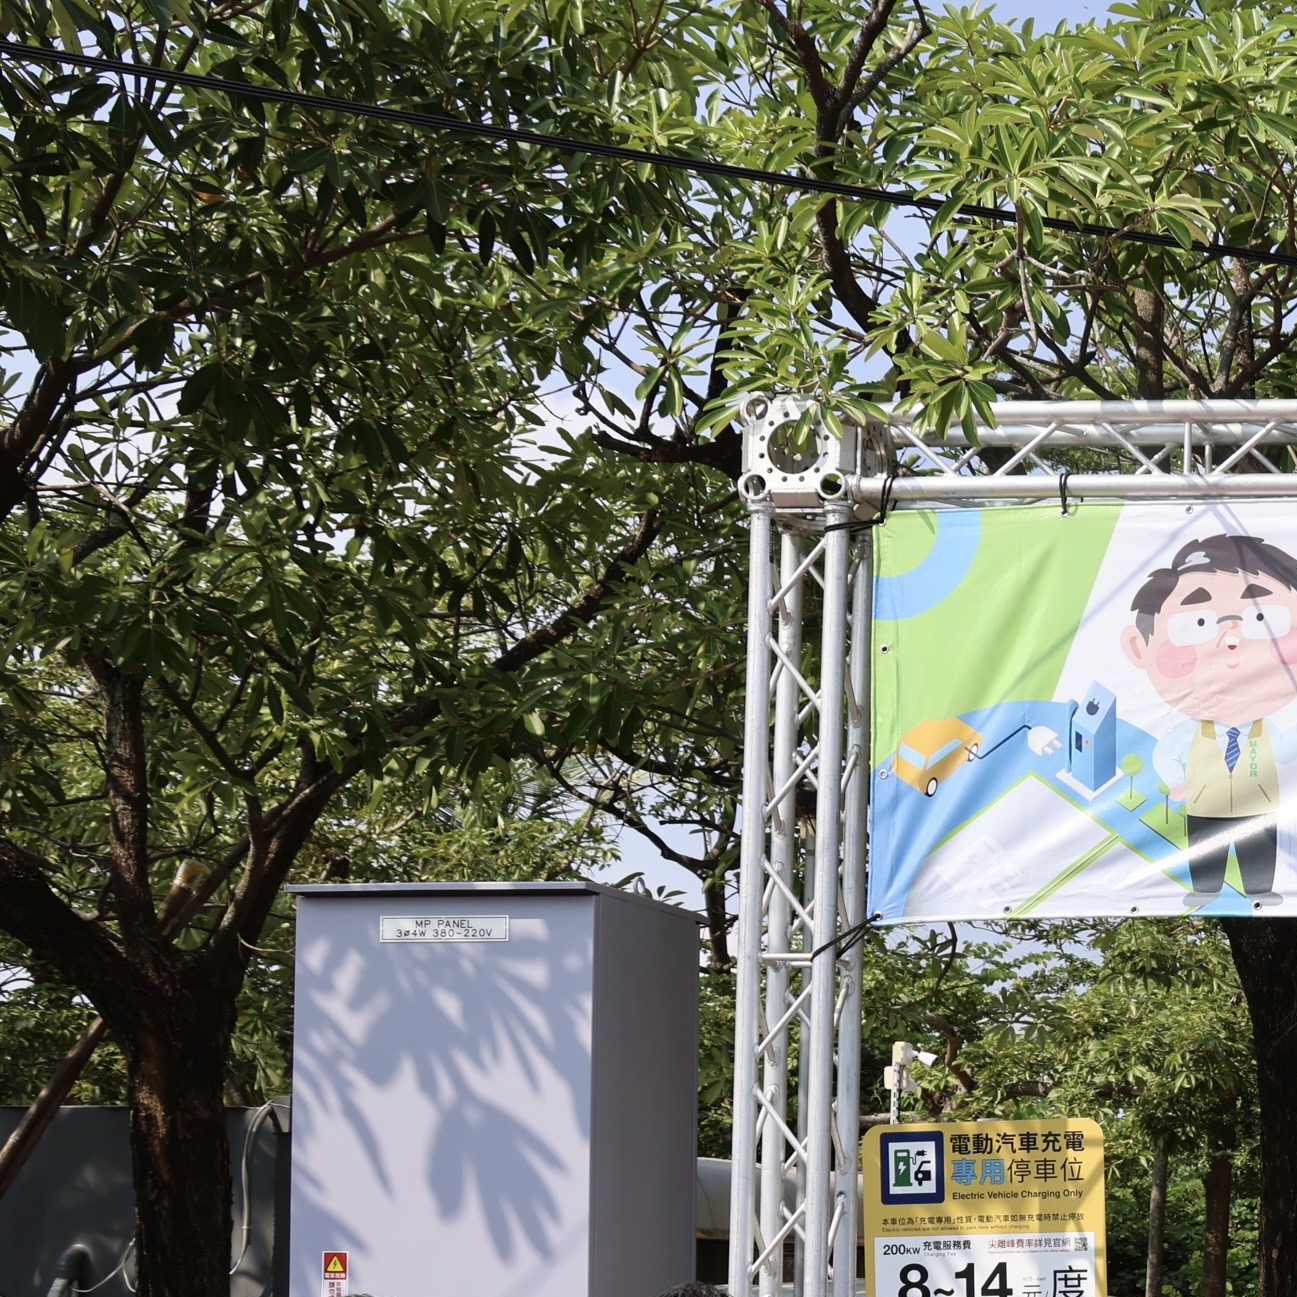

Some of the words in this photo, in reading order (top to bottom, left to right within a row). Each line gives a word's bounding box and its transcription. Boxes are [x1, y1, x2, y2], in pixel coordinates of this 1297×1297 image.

[1249, 740, 1258, 777] MAYOR
[415, 920, 431, 928] MP
[438, 920, 473, 928] PANEL
[433, 928, 493, 938] 380-220V
[949, 1130, 1085, 1155] 電動汽車充電
[951, 1157, 1085, 1186] 專用停車位
[952, 1191, 985, 1200] Electric
[987, 1190, 1019, 1199] Vehicle
[1020, 1189, 1060, 1200] Charging
[1063, 1189, 1083, 1198] Only
[883, 1244, 921, 1256] 200KW
[923, 1240, 971, 1251] 充電服務費
